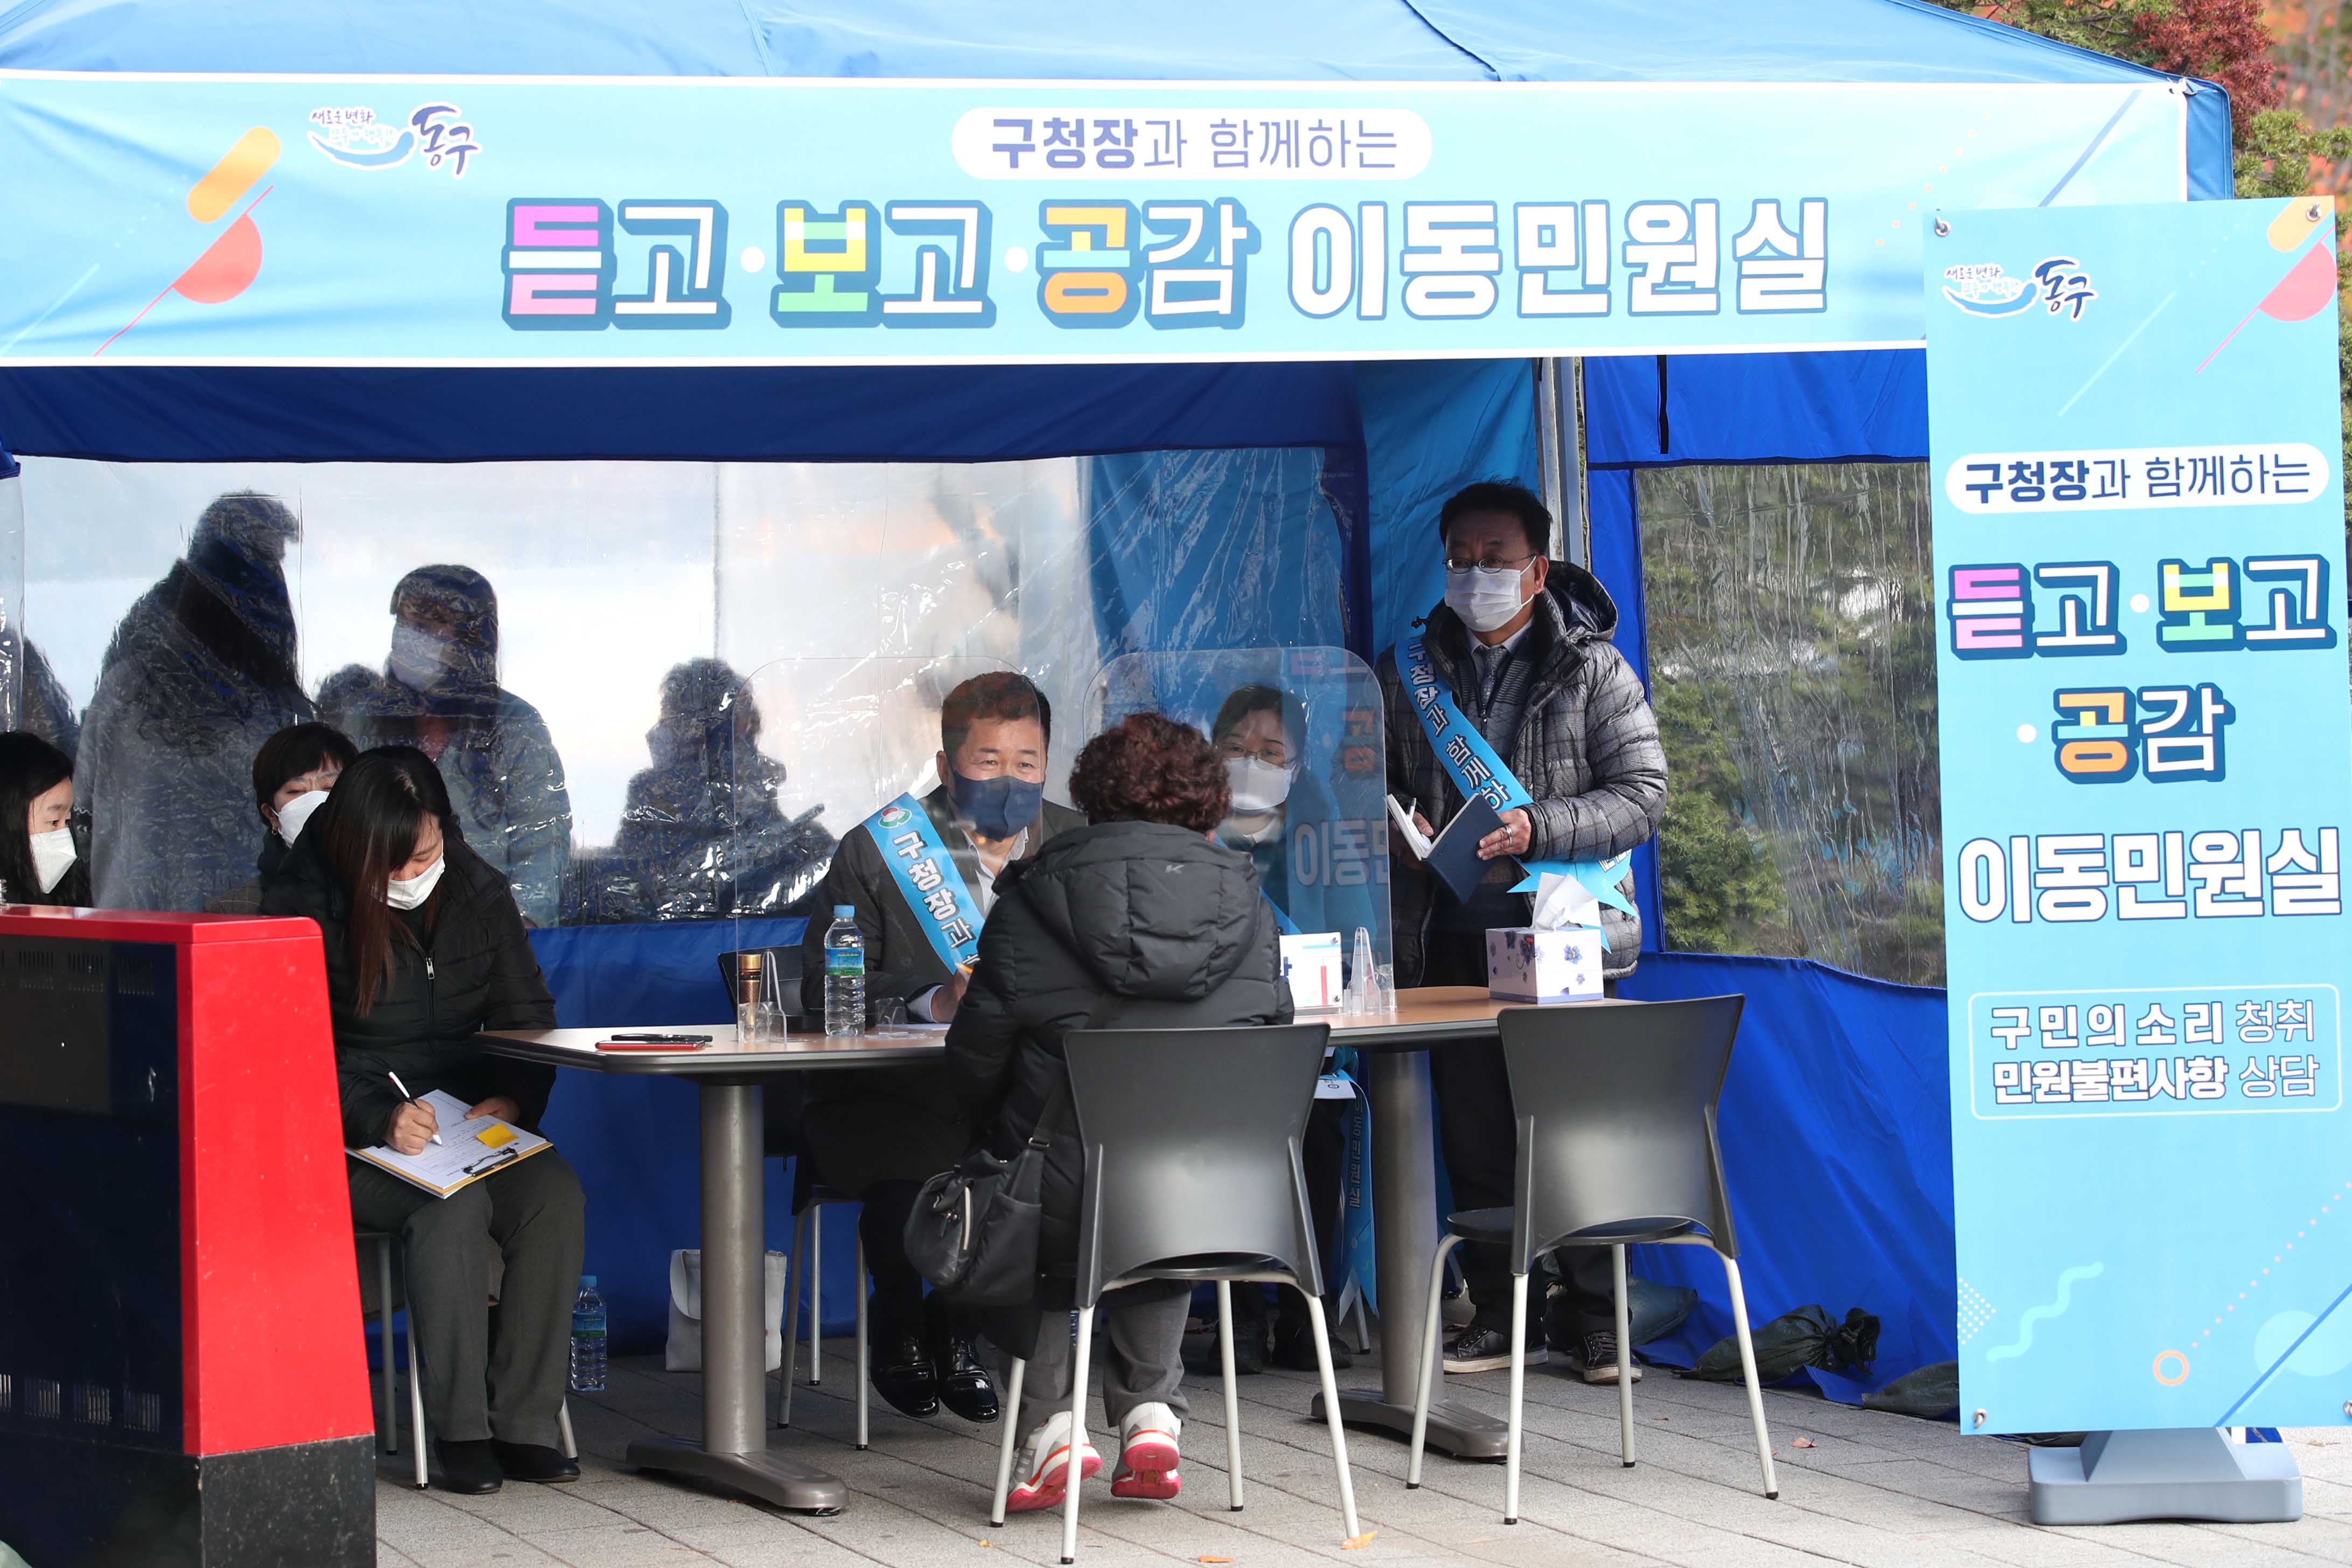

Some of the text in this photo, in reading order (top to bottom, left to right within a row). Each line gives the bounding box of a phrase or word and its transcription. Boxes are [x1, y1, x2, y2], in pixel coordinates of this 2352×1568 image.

[311, 108, 374, 124] 새로운 변화
[411, 106, 479, 175] 동구
[991, 117, 1398, 170] 구청장과 함께하는
[1287, 197, 1828, 320] 이동민원실
[1946, 266, 2001, 280] 새로운 변화
[2034, 259, 2095, 319] 동구
[1965, 453, 2311, 505] 구청장과 함께하는
[892, 830, 977, 950] 구청장과
[1957, 827, 2342, 923] 이동민원실
[2235, 999, 2314, 1044] 청취
[1992, 1054, 2321, 1105] 민원불편사항 상담
